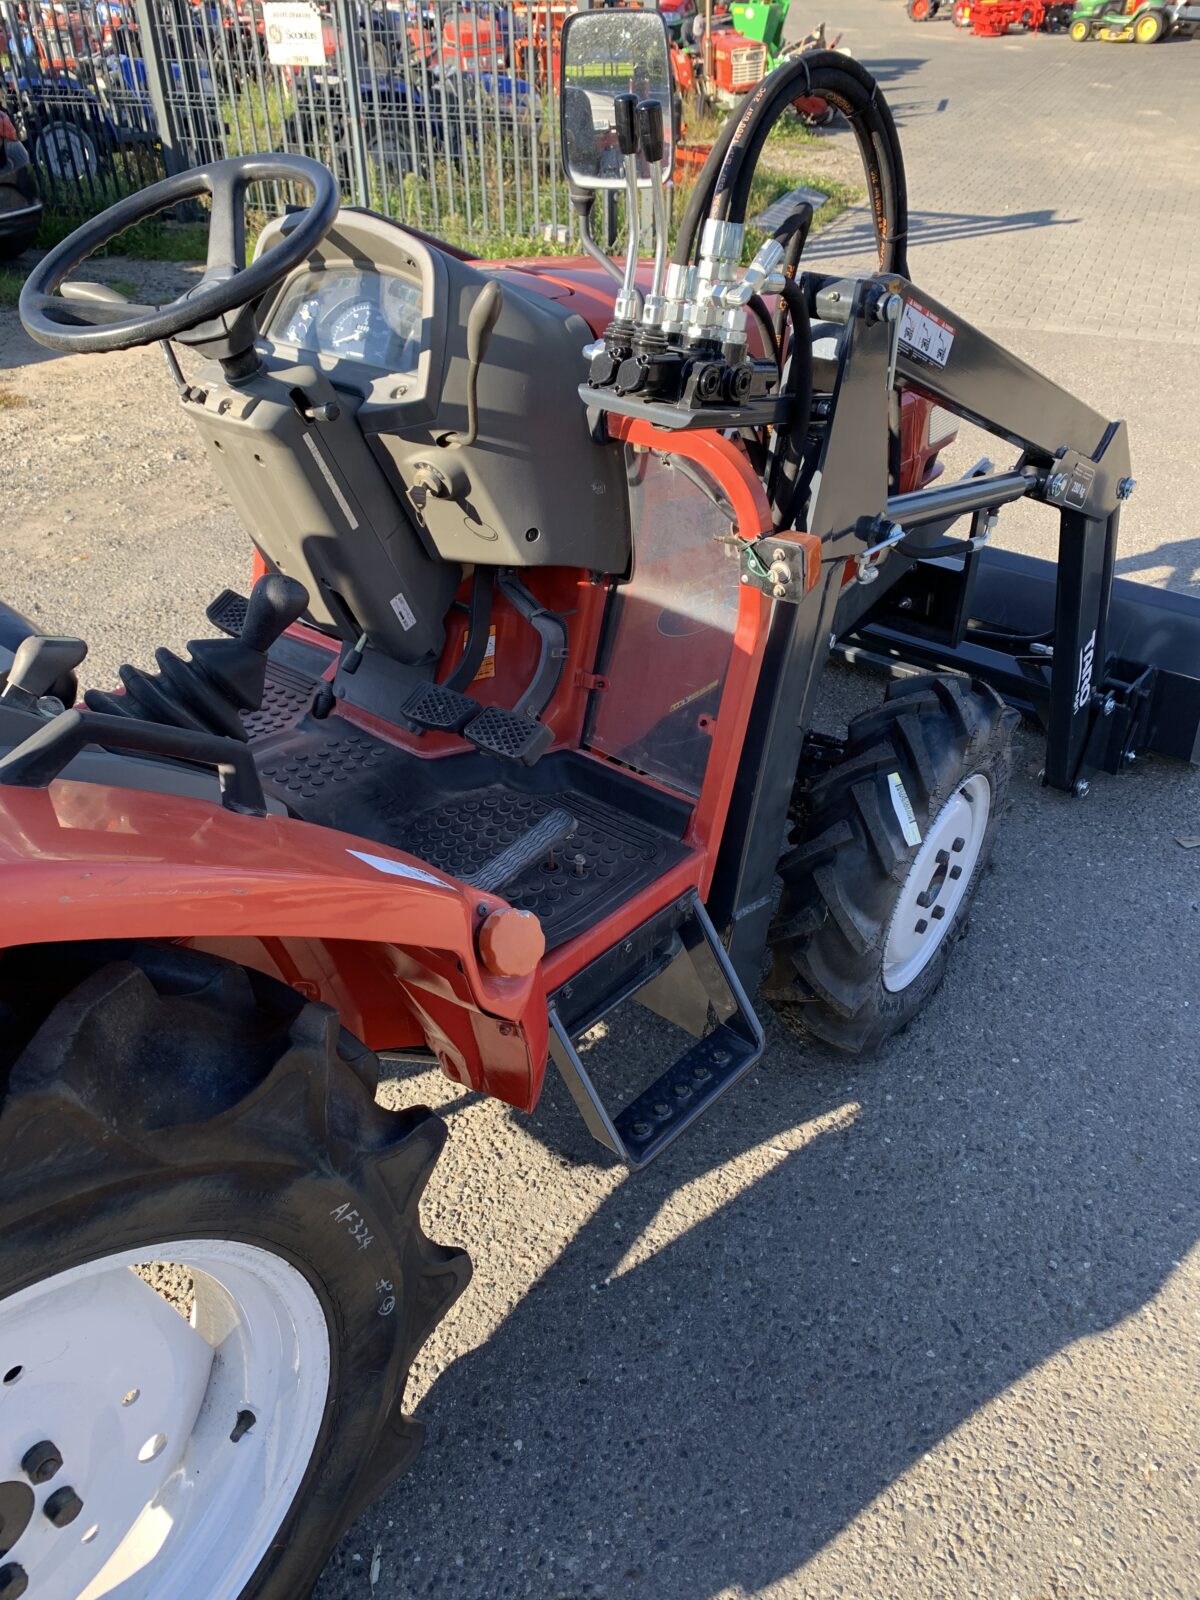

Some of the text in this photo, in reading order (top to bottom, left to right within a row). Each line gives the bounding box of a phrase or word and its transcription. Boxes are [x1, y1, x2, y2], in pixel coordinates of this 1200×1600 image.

[744, 107, 755, 122] bar
[1080, 629, 1096, 708] TARO
[329, 1201, 375, 1250] AF324
